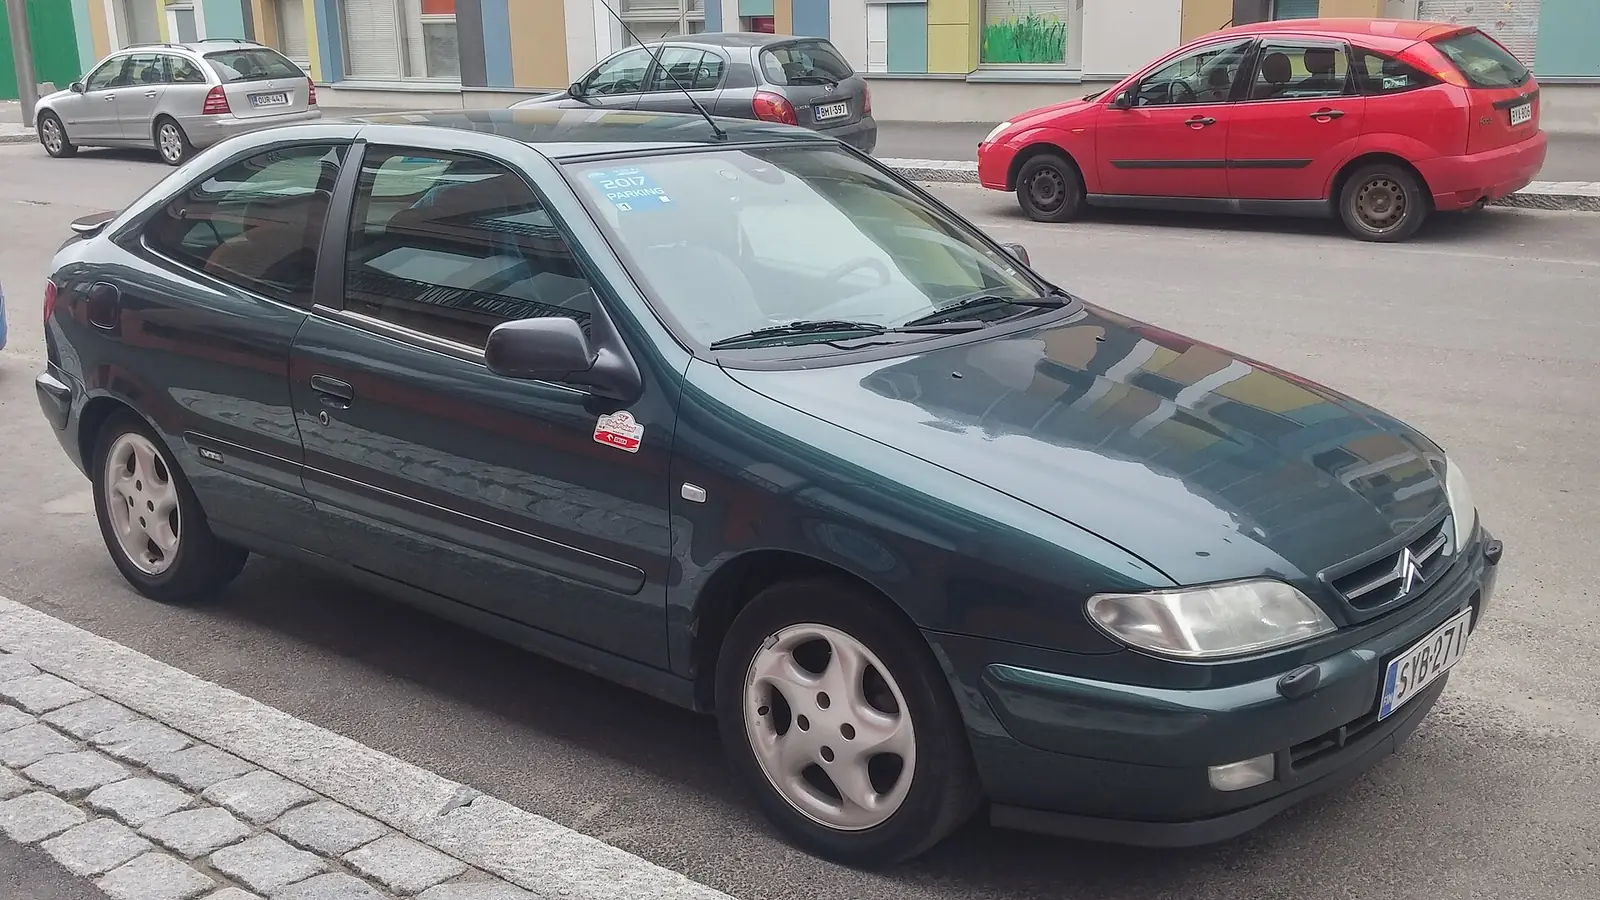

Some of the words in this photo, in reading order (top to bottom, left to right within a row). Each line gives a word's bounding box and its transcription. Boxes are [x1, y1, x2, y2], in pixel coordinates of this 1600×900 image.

[820, 104, 845, 117] BMI-397
[600, 176, 645, 189] 2017
[606, 187, 664, 200] PARKING
[1397, 622, 1463, 699] SYB-271
